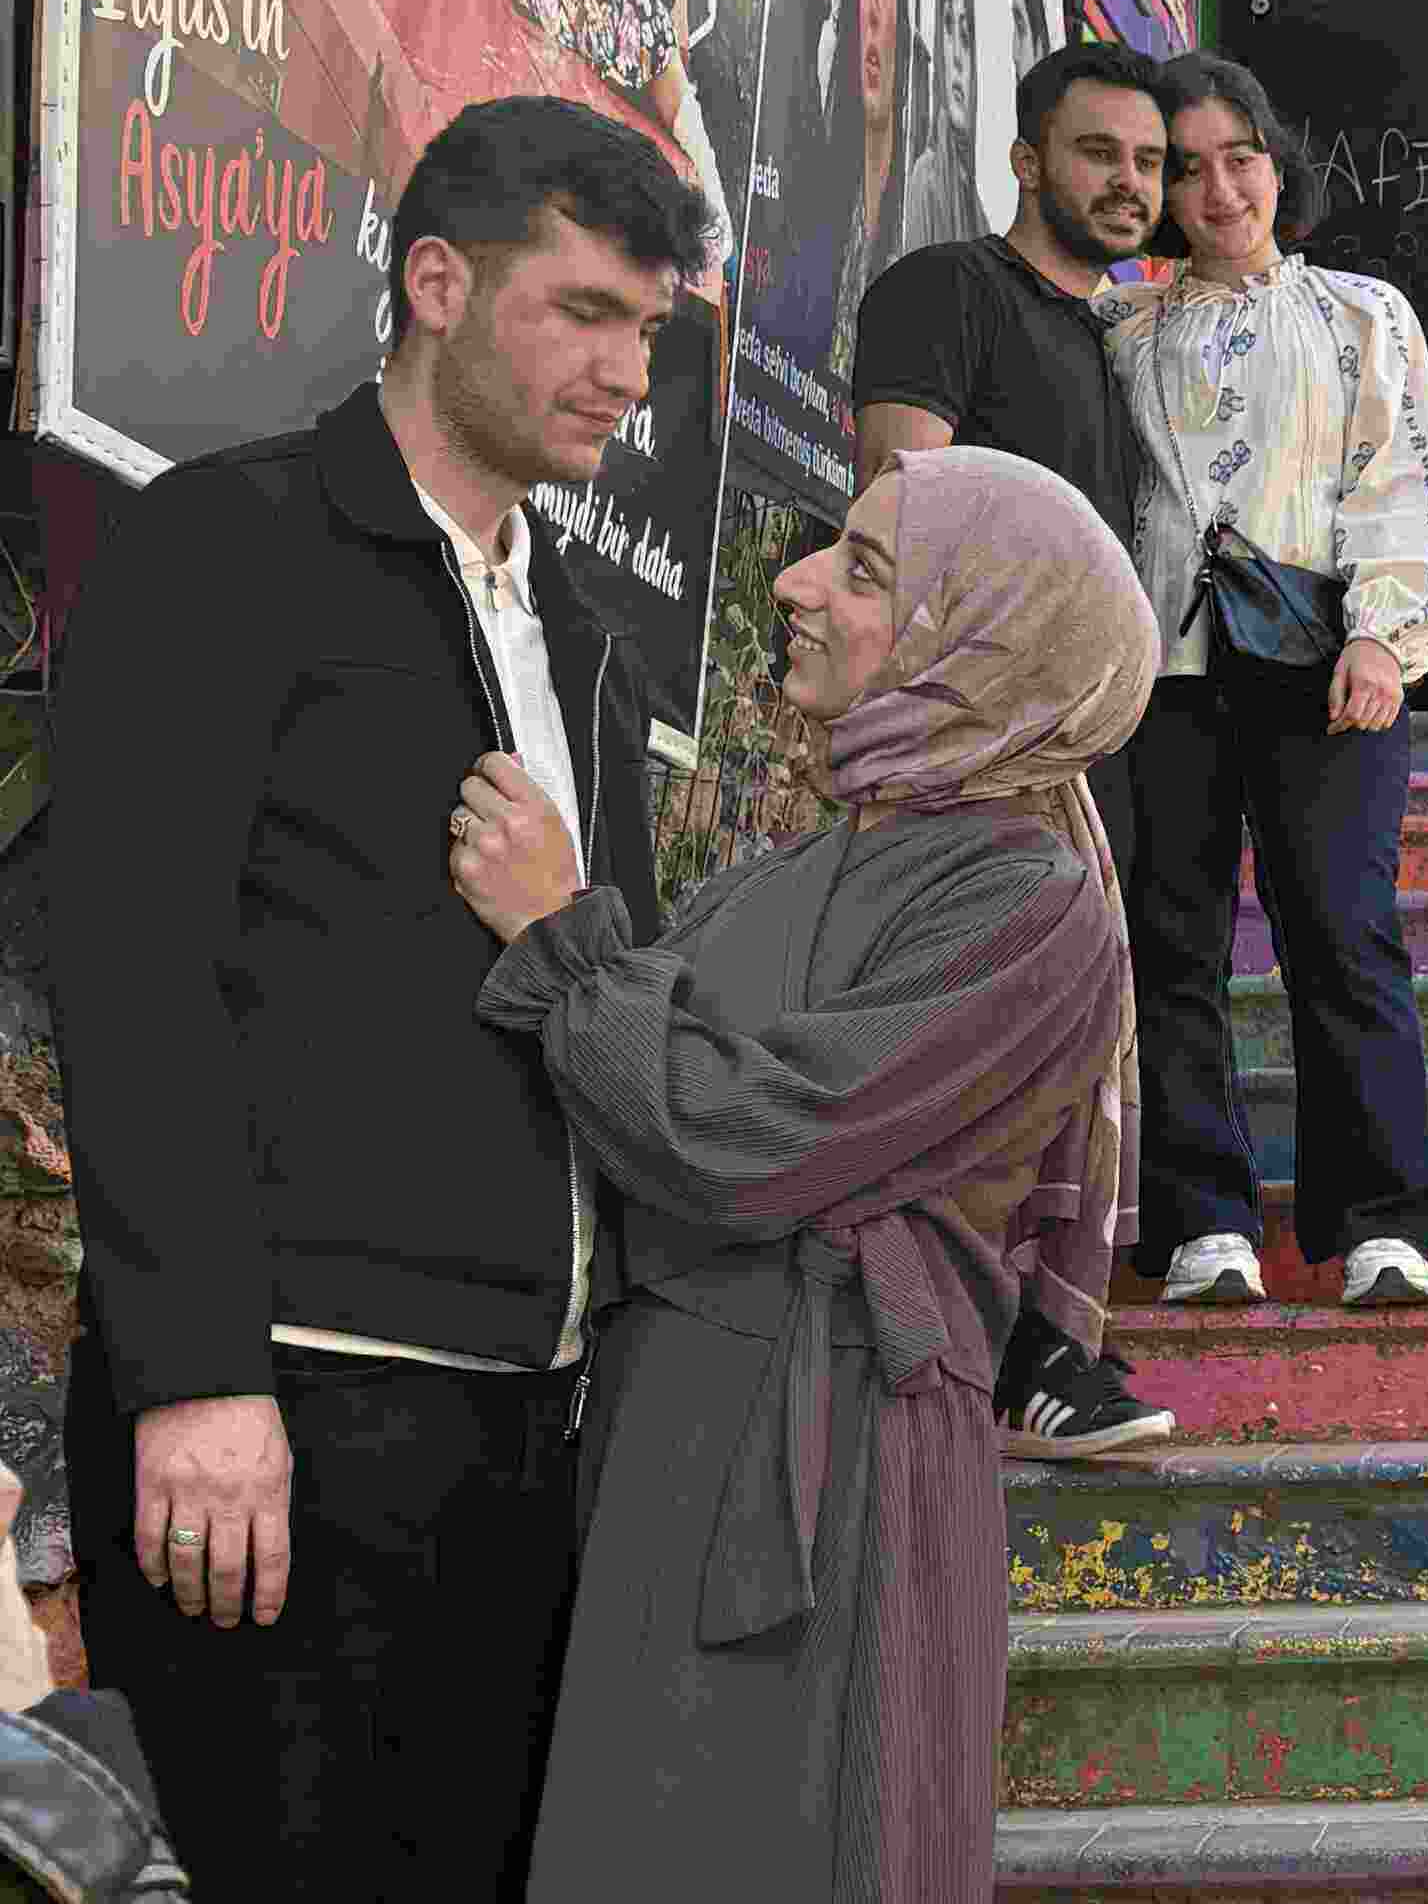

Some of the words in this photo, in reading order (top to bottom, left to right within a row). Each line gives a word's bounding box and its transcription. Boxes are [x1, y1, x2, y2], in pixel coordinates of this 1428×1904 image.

[119, 98, 335, 339] Asya'ya
[734, 394, 761, 438] veda
[597, 493, 631, 566] bir
[632, 515, 685, 601] daha
